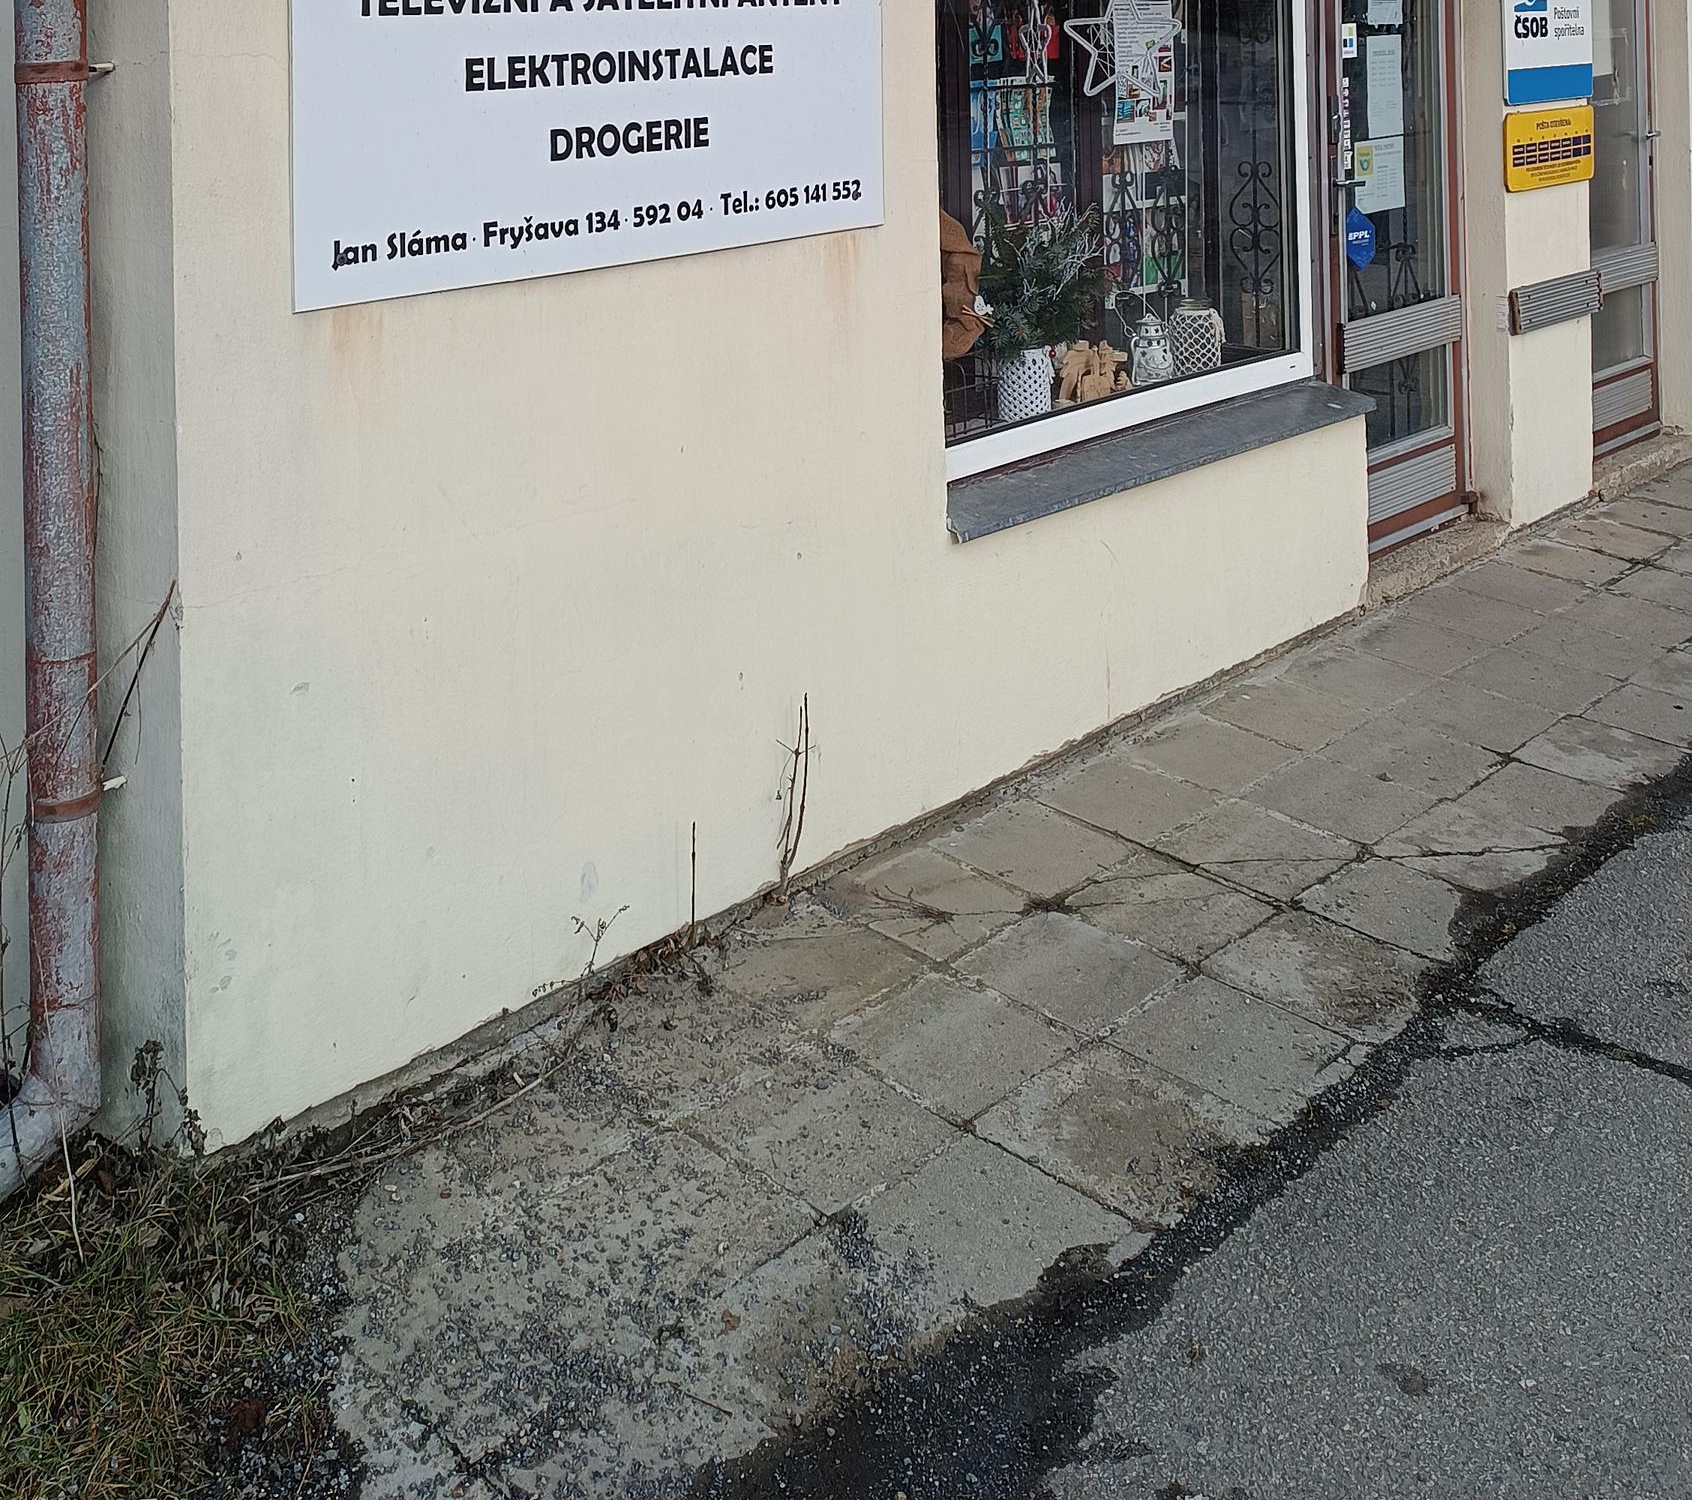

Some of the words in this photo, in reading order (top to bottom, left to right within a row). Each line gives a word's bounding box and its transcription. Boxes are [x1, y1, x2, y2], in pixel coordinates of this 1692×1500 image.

[1514, 14, 1548, 39] ČSOB
[1553, 6, 1580, 19] Poštovní
[1554, 23, 1585, 40] spořitelna
[465, 44, 774, 92] ELEKTROINSTALACE
[550, 116, 710, 162] DROGERIE
[331, 240, 378, 272] Jan
[386, 229, 468, 261] Sláma
[483, 215, 579, 250] Fryšava
[585, 209, 621, 234] 134
[633, 203, 671, 228] 592
[676, 198, 704, 222] 04
[719, 190, 760, 216] Tel.:
[765, 186, 799, 210] 605
[803, 182, 827, 205] 141
[832, 179, 862, 201] 552
